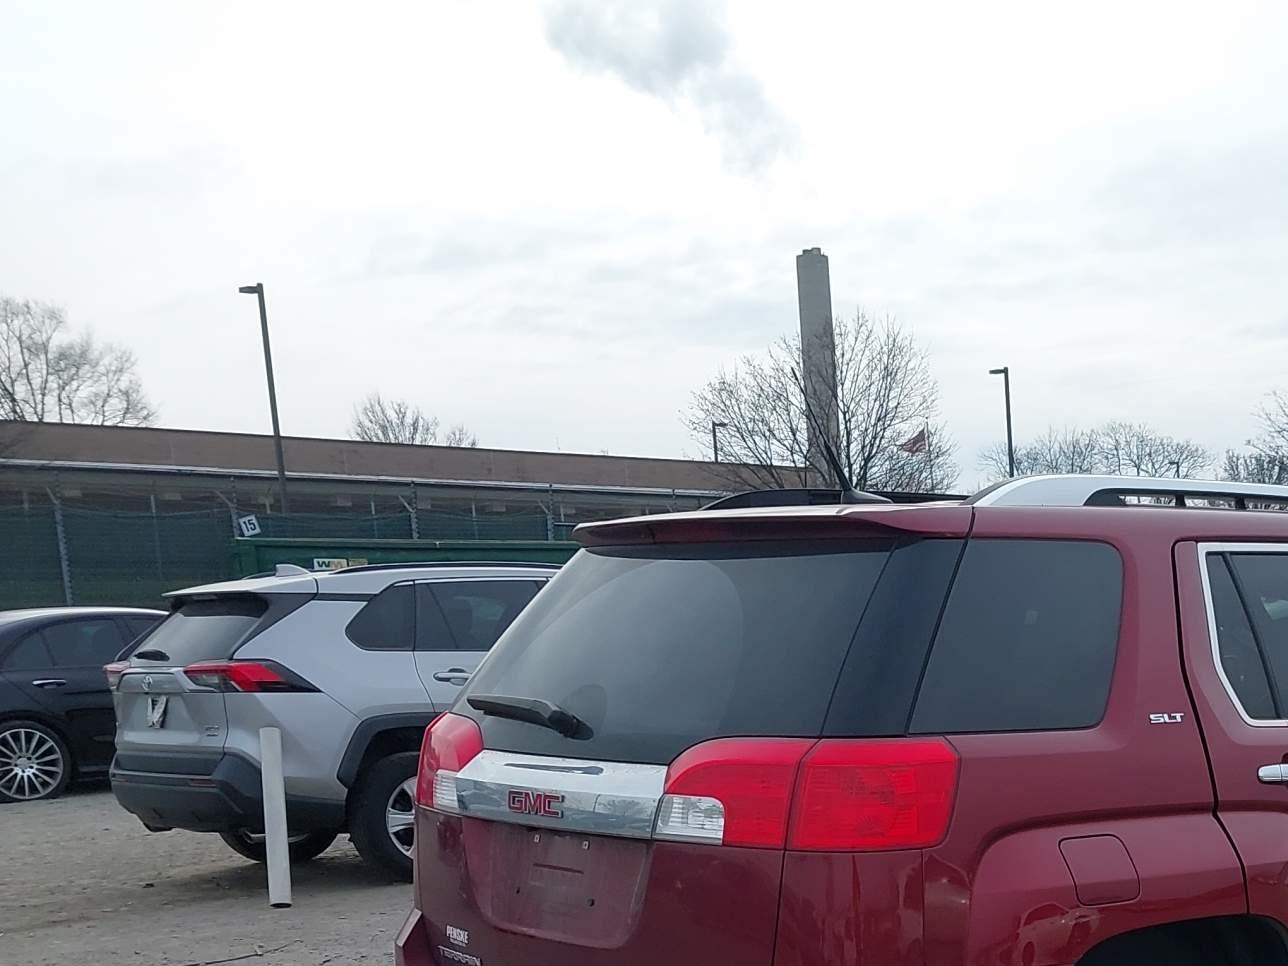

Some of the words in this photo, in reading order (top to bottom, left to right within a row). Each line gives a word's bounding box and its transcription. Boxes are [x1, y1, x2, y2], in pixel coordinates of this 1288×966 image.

[242, 518, 257, 532] 15
[316, 559, 343, 569] WM
[1149, 712, 1185, 724] SLT
[507, 788, 564, 818] GMC
[446, 924, 469, 944] PENSKE
